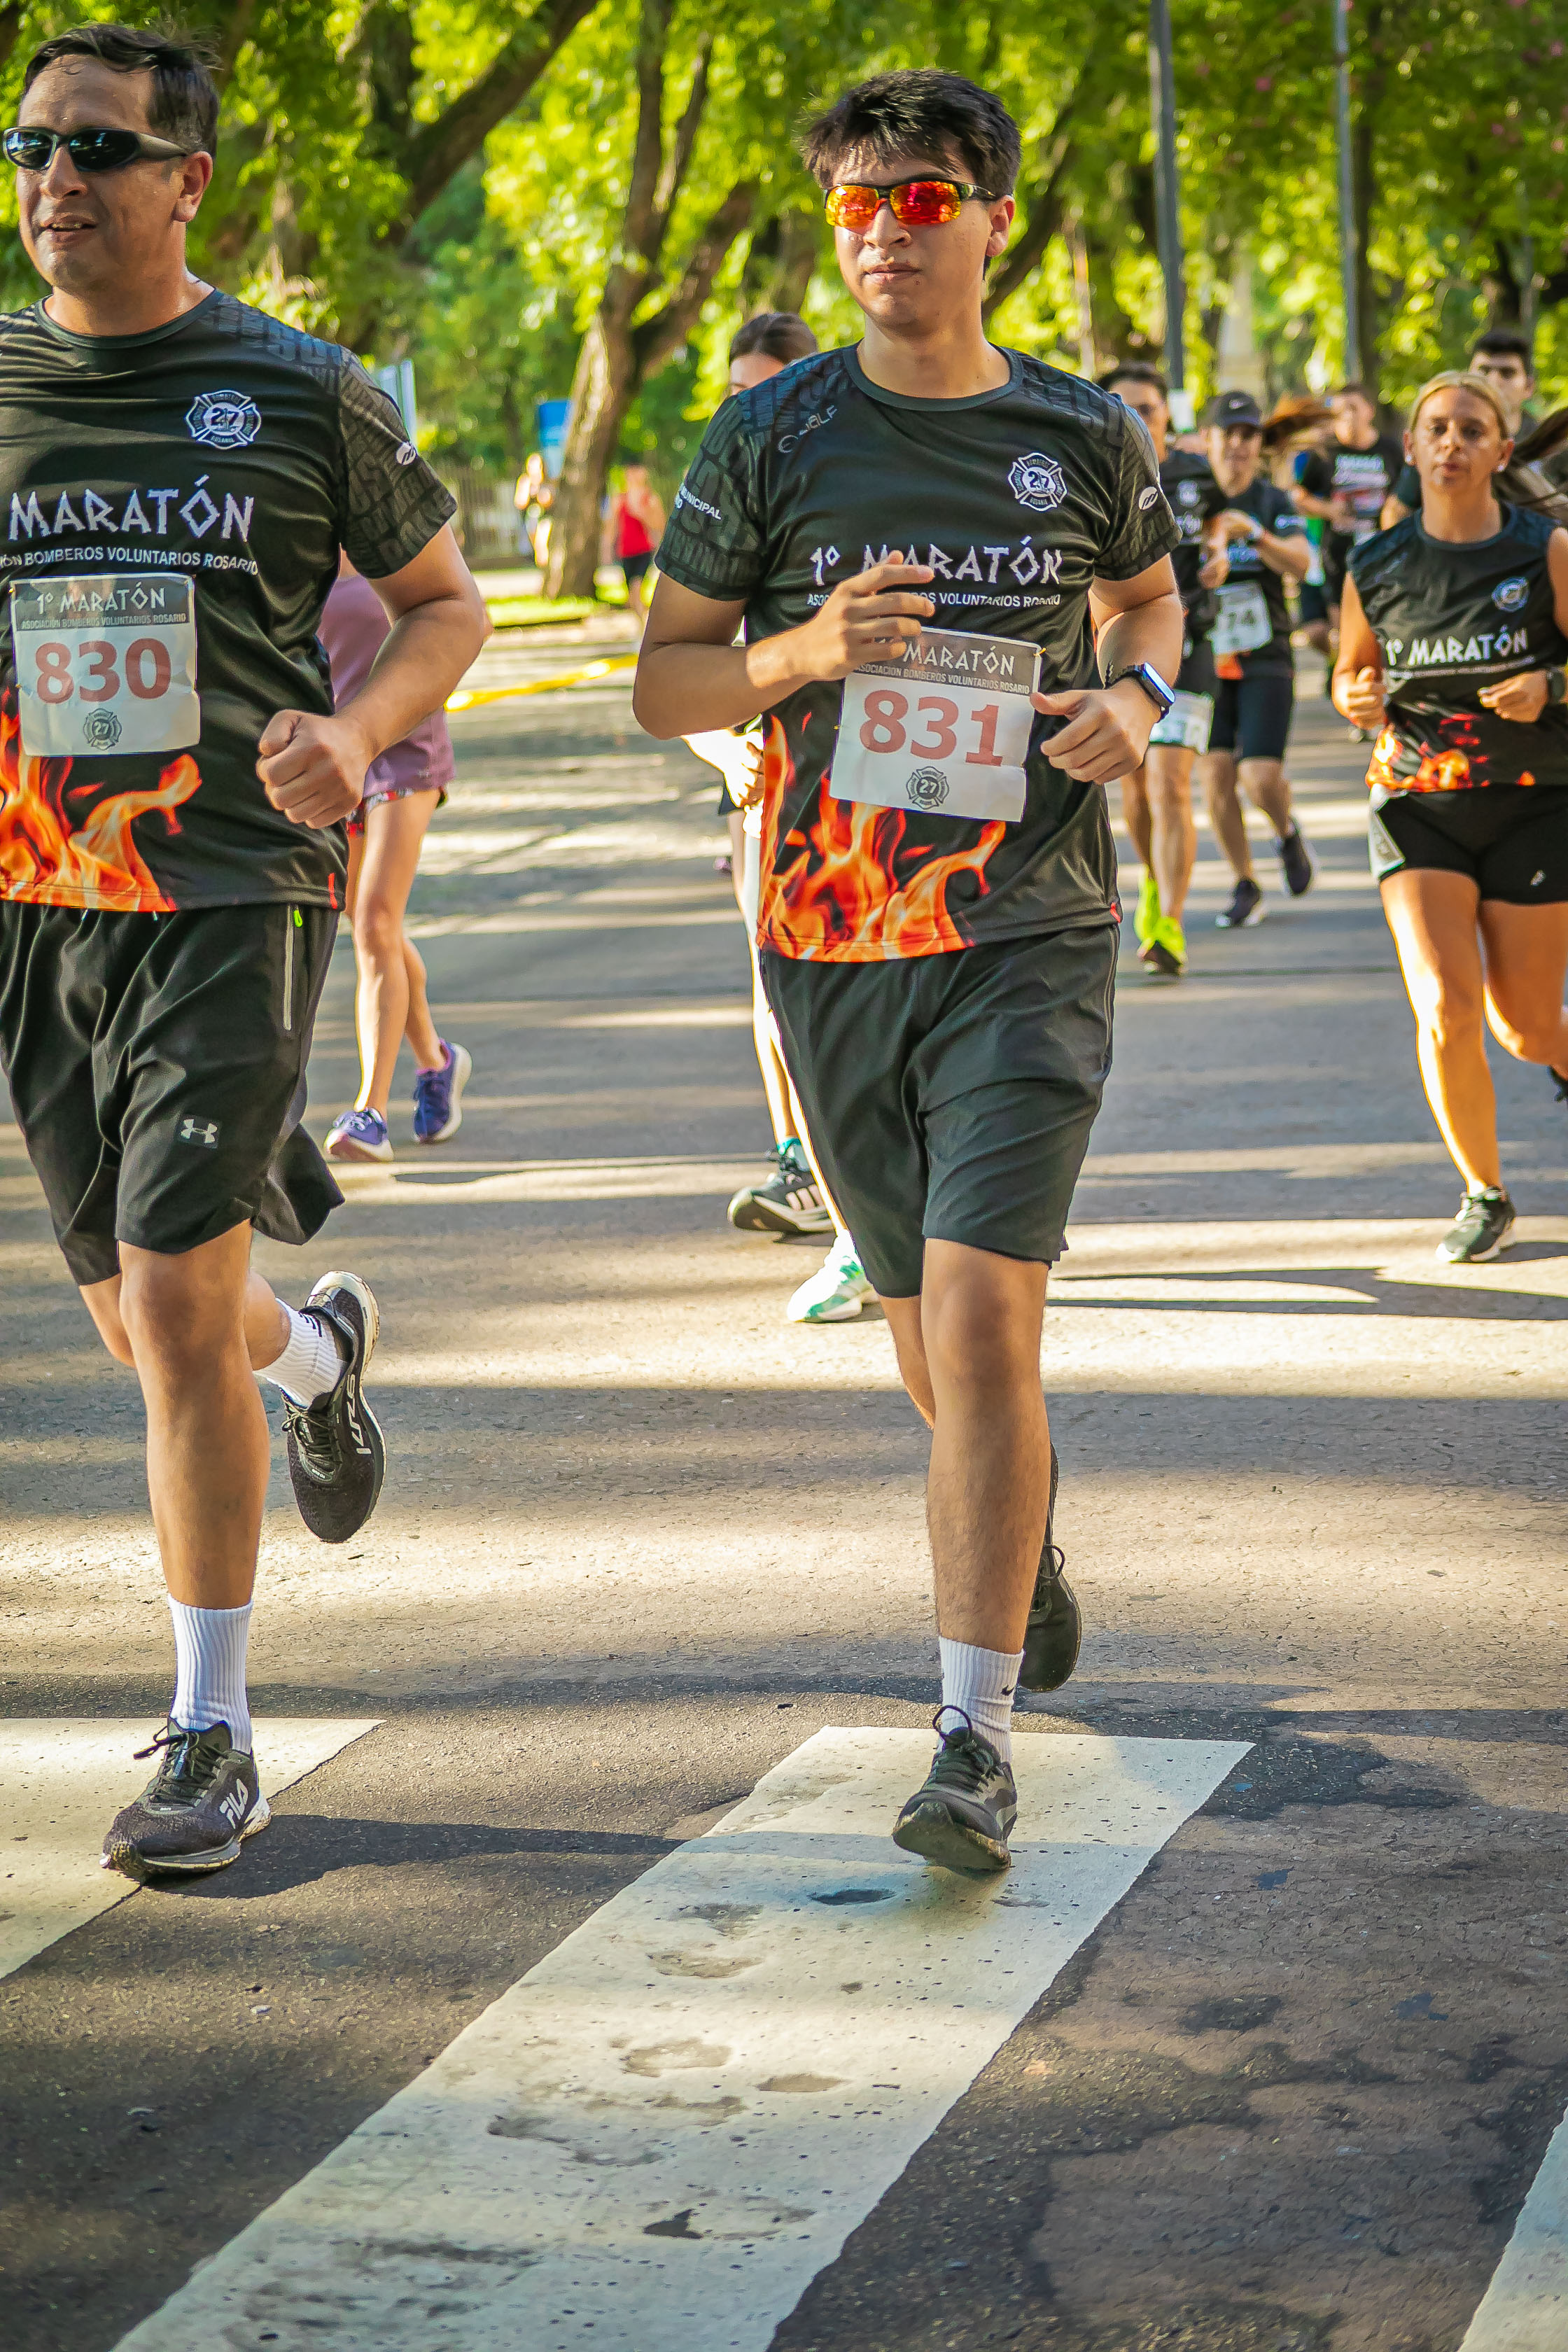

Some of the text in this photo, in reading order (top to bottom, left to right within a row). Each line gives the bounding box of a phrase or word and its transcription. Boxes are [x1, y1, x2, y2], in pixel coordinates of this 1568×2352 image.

[210, 407, 240, 426] 27
[1028, 470, 1049, 489] 27
[8, 474, 254, 542] MARATÓN
[24, 546, 104, 566] BOMBEROS
[107, 546, 201, 566] VOLUNTARIOS
[203, 552, 259, 576] ROSARIO
[59, 582, 165, 613] MARATÓN
[939, 592, 1021, 608] VOLUNTARIOS
[101, 615, 152, 626] VOLUNTARIOS
[153, 612, 187, 623] ROSARIO
[903, 642, 1014, 676] MARATÓN
[1408, 624, 1529, 666] MARATÓN
[36, 637, 172, 704] 830
[903, 668, 946, 683] BOMBEROS
[948, 673, 999, 690] VOLUNTARIOS
[1000, 680, 1030, 694] ROSARIO
[860, 690, 1003, 767] 831
[919, 778, 937, 794] 27
[219, 1778, 248, 1830] FILA
